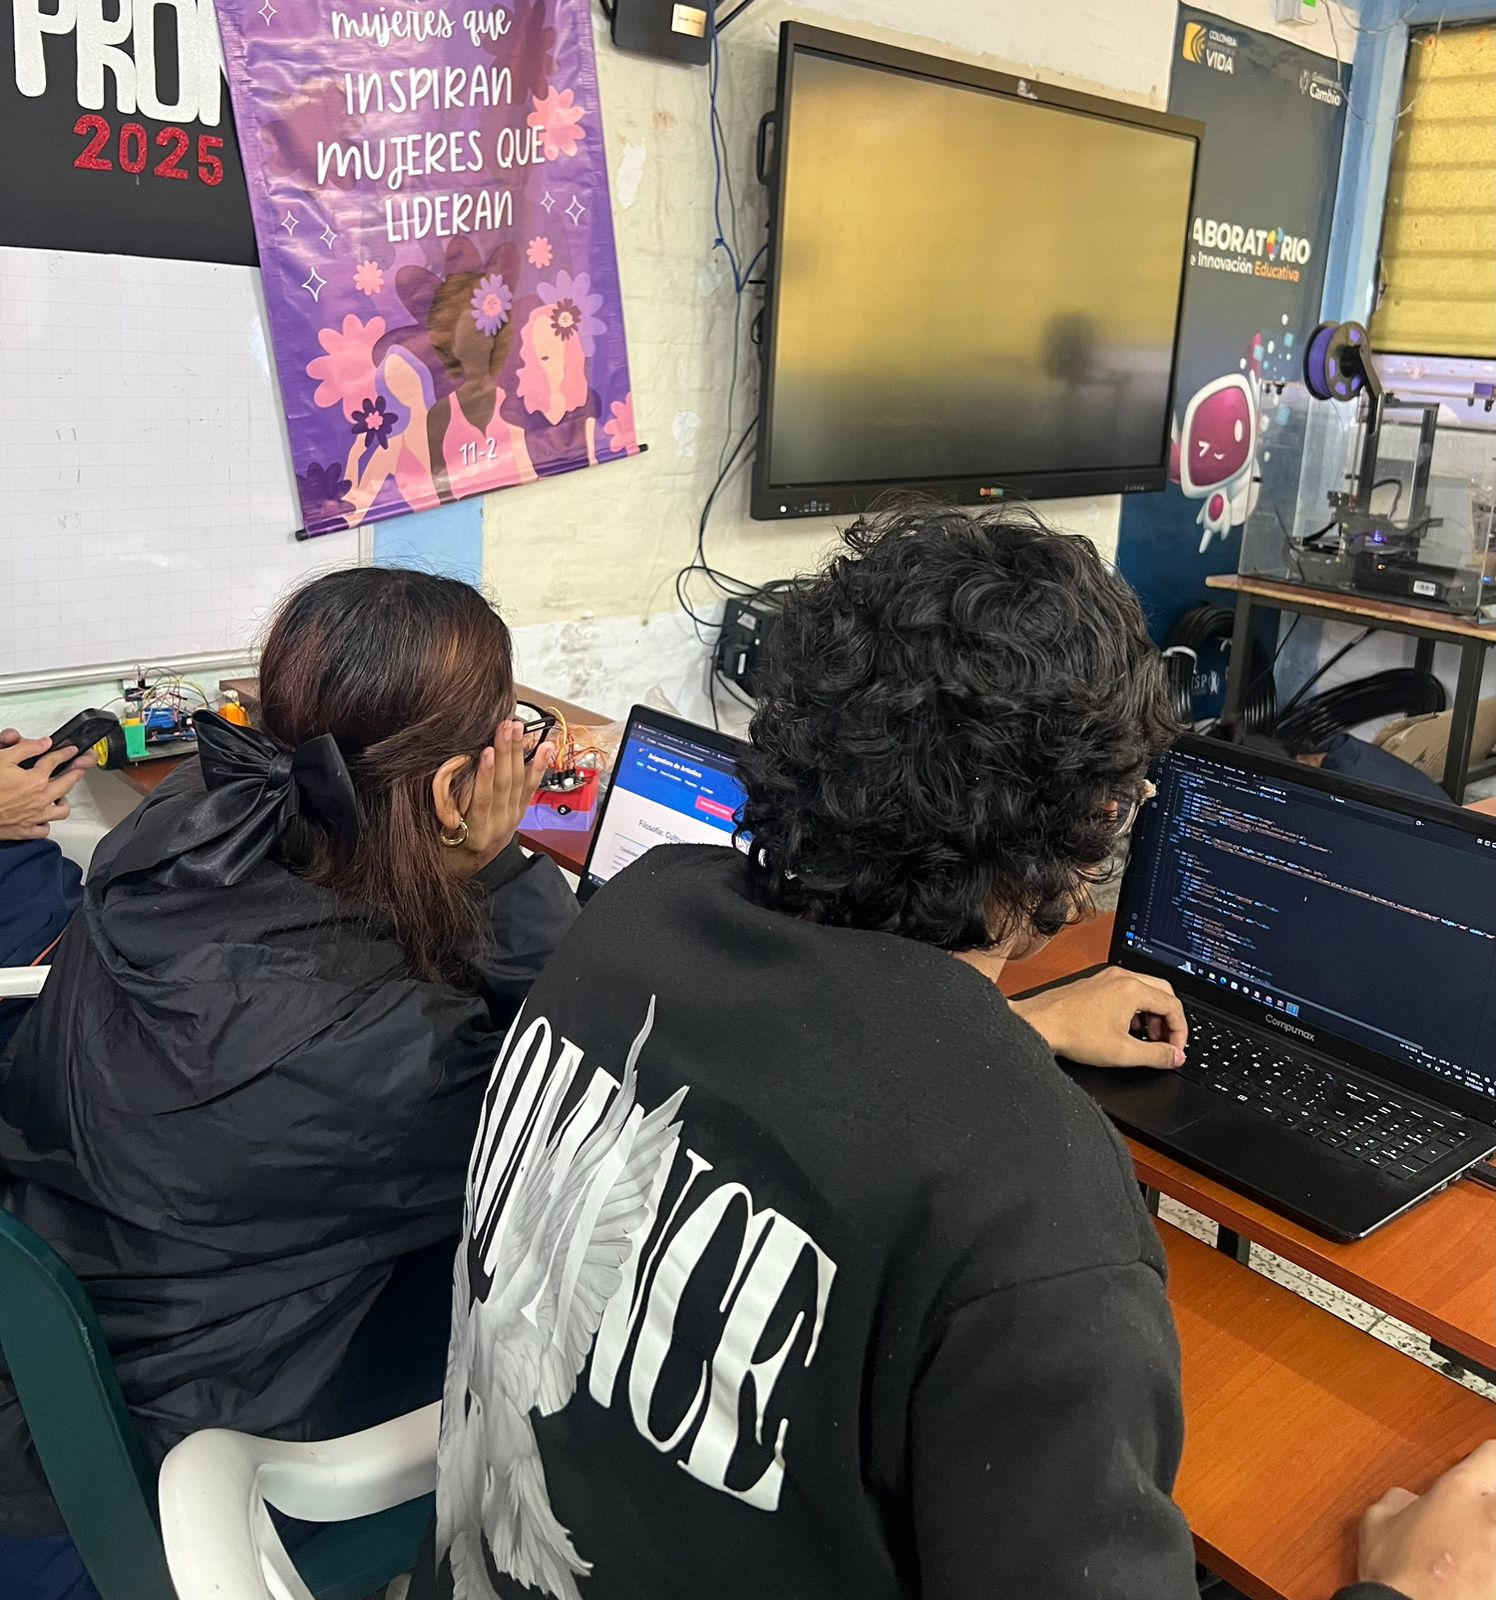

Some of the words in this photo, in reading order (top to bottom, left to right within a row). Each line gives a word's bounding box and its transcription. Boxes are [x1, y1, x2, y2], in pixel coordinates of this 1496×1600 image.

[331, 6, 456, 48] mujeres
[463, 8, 511, 47] que
[1206, 49, 1234, 75] VIDA
[345, 64, 512, 115] INSPIRAN
[1309, 83, 1342, 107] Cambio
[73, 114, 224, 186] 2025
[317, 130, 483, 190] MUJERES
[496, 125, 545, 169] QUE
[385, 190, 513, 242] LIDERAN
[1192, 217, 1311, 265] ABORATORIO
[1198, 251, 1253, 275] Innovación
[1254, 260, 1300, 282] Educativa
[459, 436, 498, 466] 11-2
[1265, 1013, 1315, 1042] Compumax
[471, 996, 837, 1512] OMANCE
